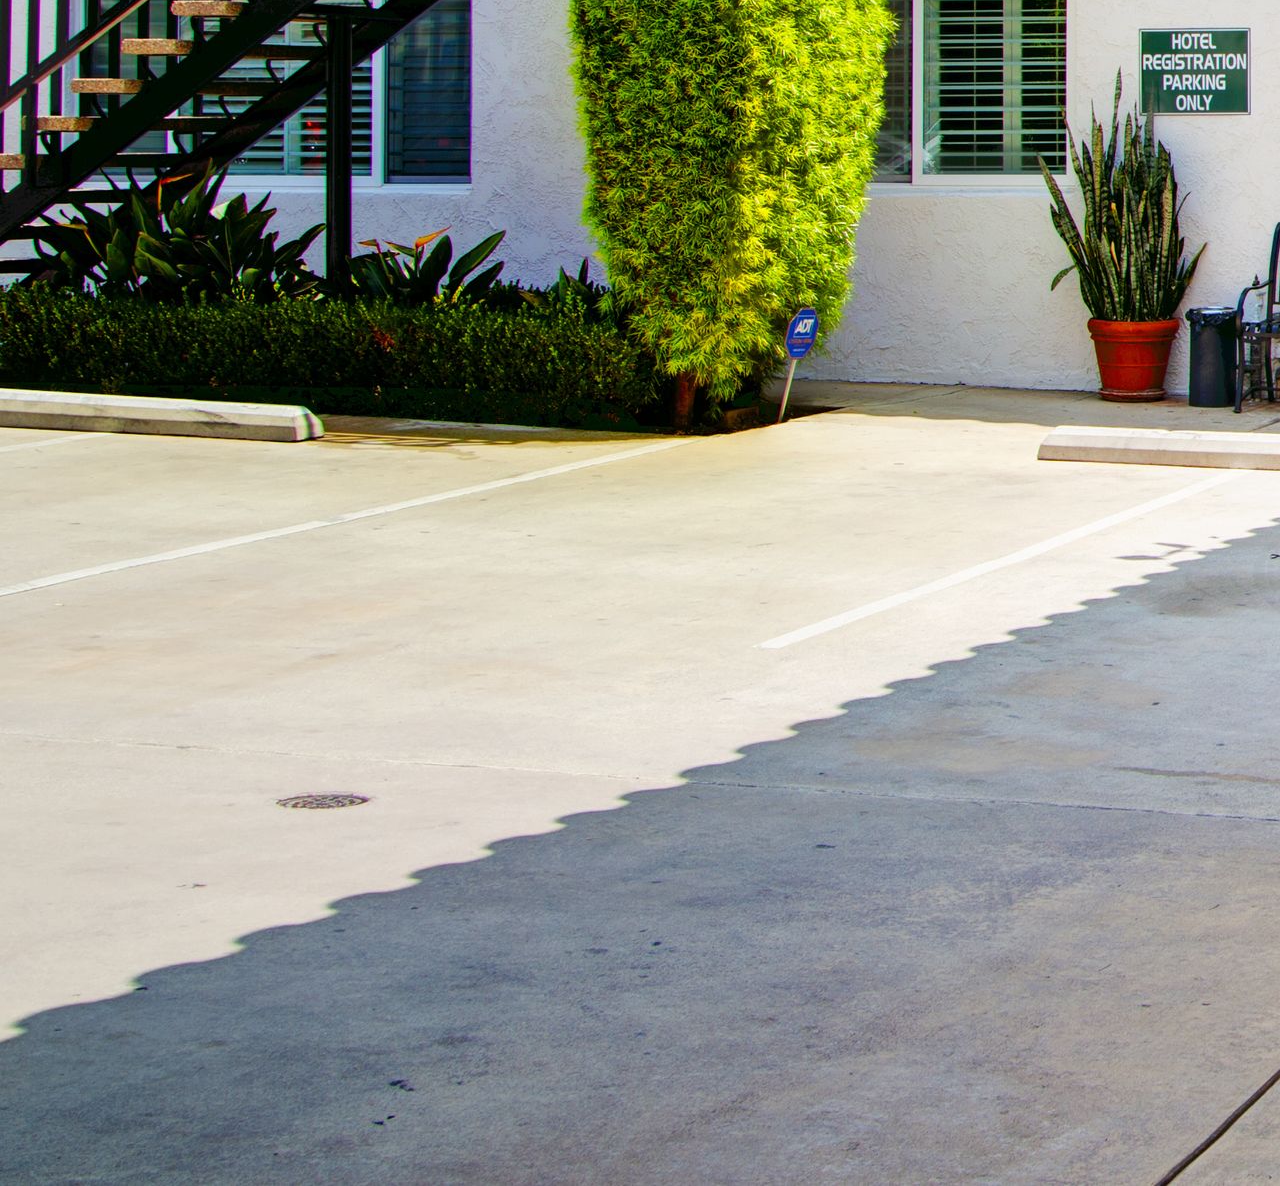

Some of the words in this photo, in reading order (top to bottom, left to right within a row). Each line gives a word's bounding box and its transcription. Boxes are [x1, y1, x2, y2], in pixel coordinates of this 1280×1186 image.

[1171, 33, 1217, 50] HOTEL
[1142, 53, 1247, 70] REGISTRATION
[1162, 74, 1227, 91] PARKING
[1175, 94, 1213, 111] ONLY
[794, 318, 814, 334] ADT
